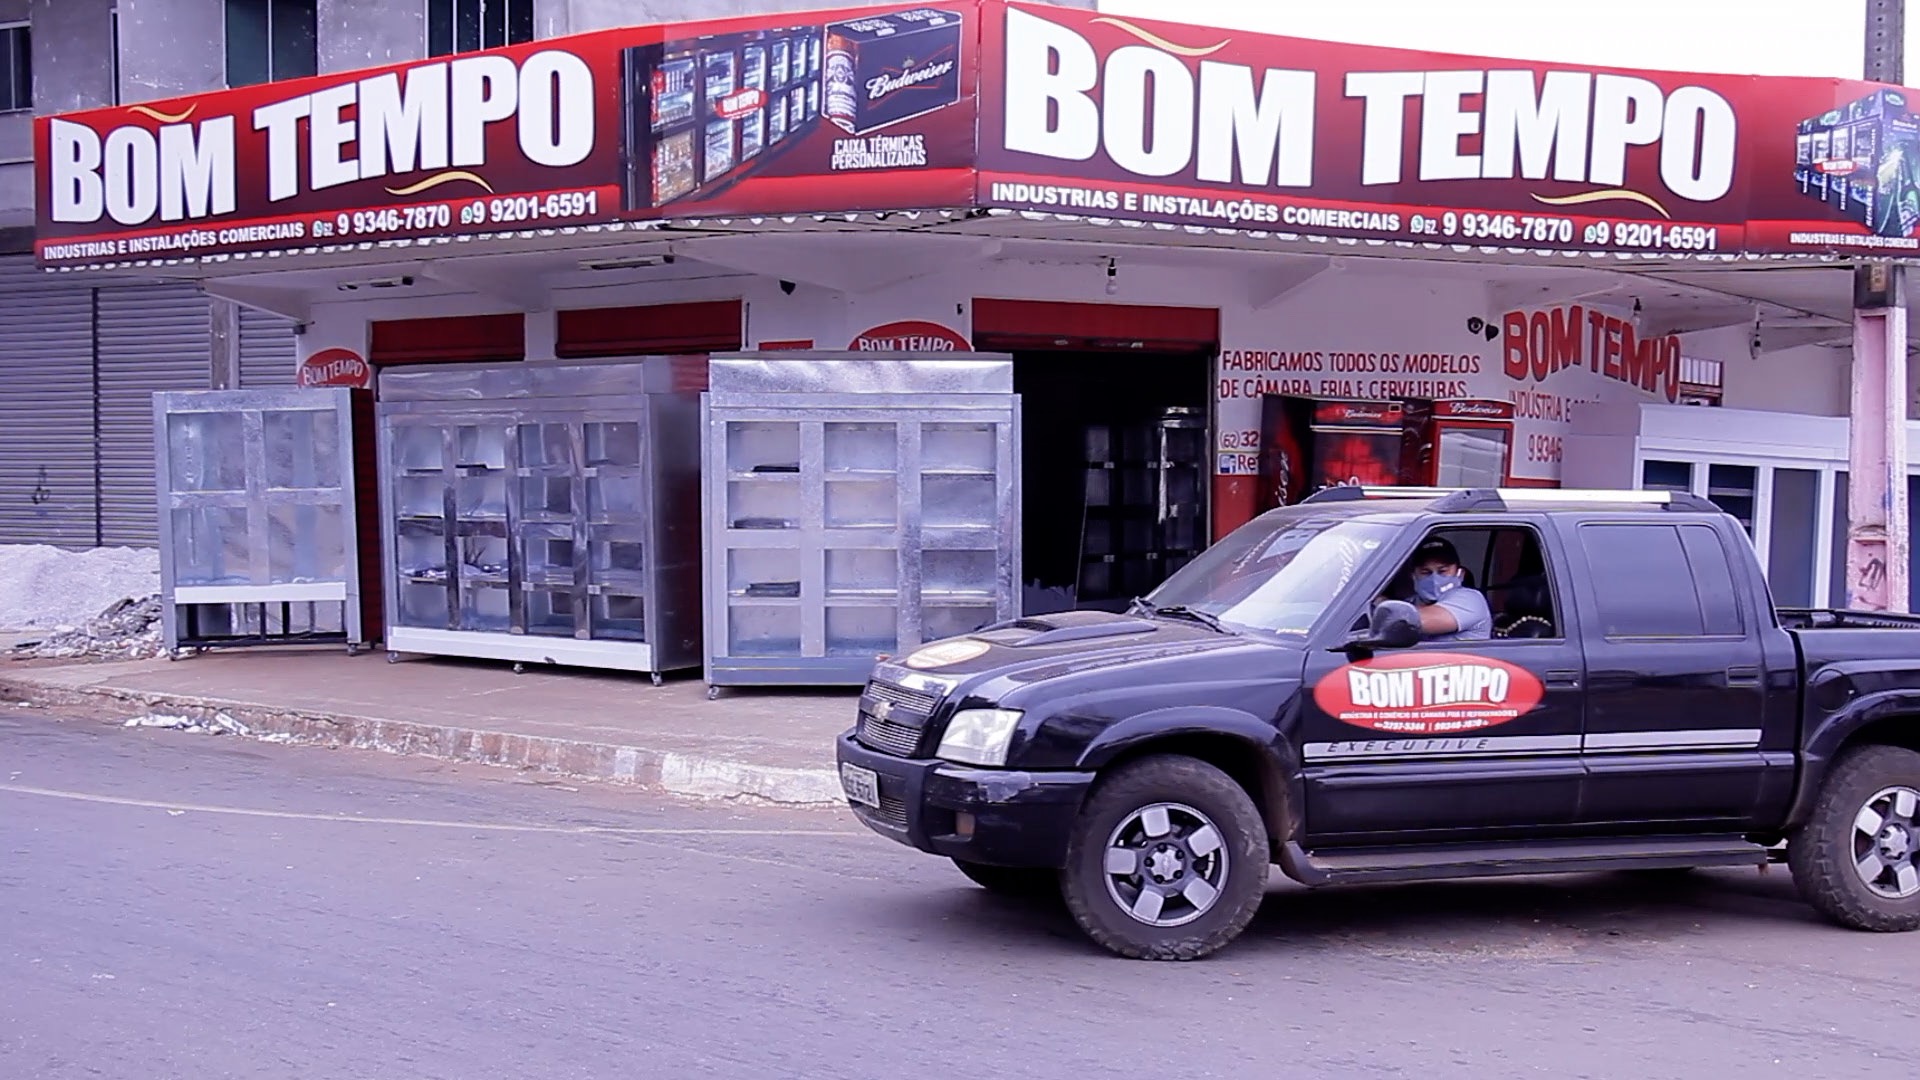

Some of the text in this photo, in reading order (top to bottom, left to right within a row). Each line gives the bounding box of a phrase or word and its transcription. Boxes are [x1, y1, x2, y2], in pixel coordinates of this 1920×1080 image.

[866, 60, 953, 99] Budweiser
[1005, 5, 1736, 201] BOM TEMPO
[51, 50, 596, 225] BOM TEMPO
[834, 133, 924, 155] CAIXA TÉRMICAS
[832, 150, 926, 170] PERSONALIZADAS
[44, 239, 116, 260] INDUSTRIAS
[119, 240, 127, 254] E
[128, 228, 217, 251] INSTALAÇÕES
[219, 222, 305, 245] COMERCIAIS
[353, 203, 450, 234] 9346-7870
[490, 190, 597, 223] 9201-6591
[992, 182, 1119, 210] INDUSTRIAS
[1124, 192, 1138, 212] E
[1143, 193, 1279, 224] INSTALAÇÕES
[1283, 207, 1400, 232] COMERCIAIS
[1463, 213, 1573, 243] 9346-7870
[1615, 222, 1717, 251] 9201-6591
[858, 335, 955, 351] BOM TEMPO
[1504, 305, 1681, 404] BOM TEMPO
[302, 358, 364, 385] BOM TEMPO
[1222, 350, 1481, 374] FABRICAMOS TODOS OS MODELOS
[1220, 378, 1239, 399] DE
[1243, 374, 1311, 398] CÂMARA
[1320, 379, 1351, 397] FRIA
[1238, 454, 1259, 470] Re
[1348, 664, 1509, 708] BOM TEMPO
[1327, 738, 1488, 753] EXECUTIVE
